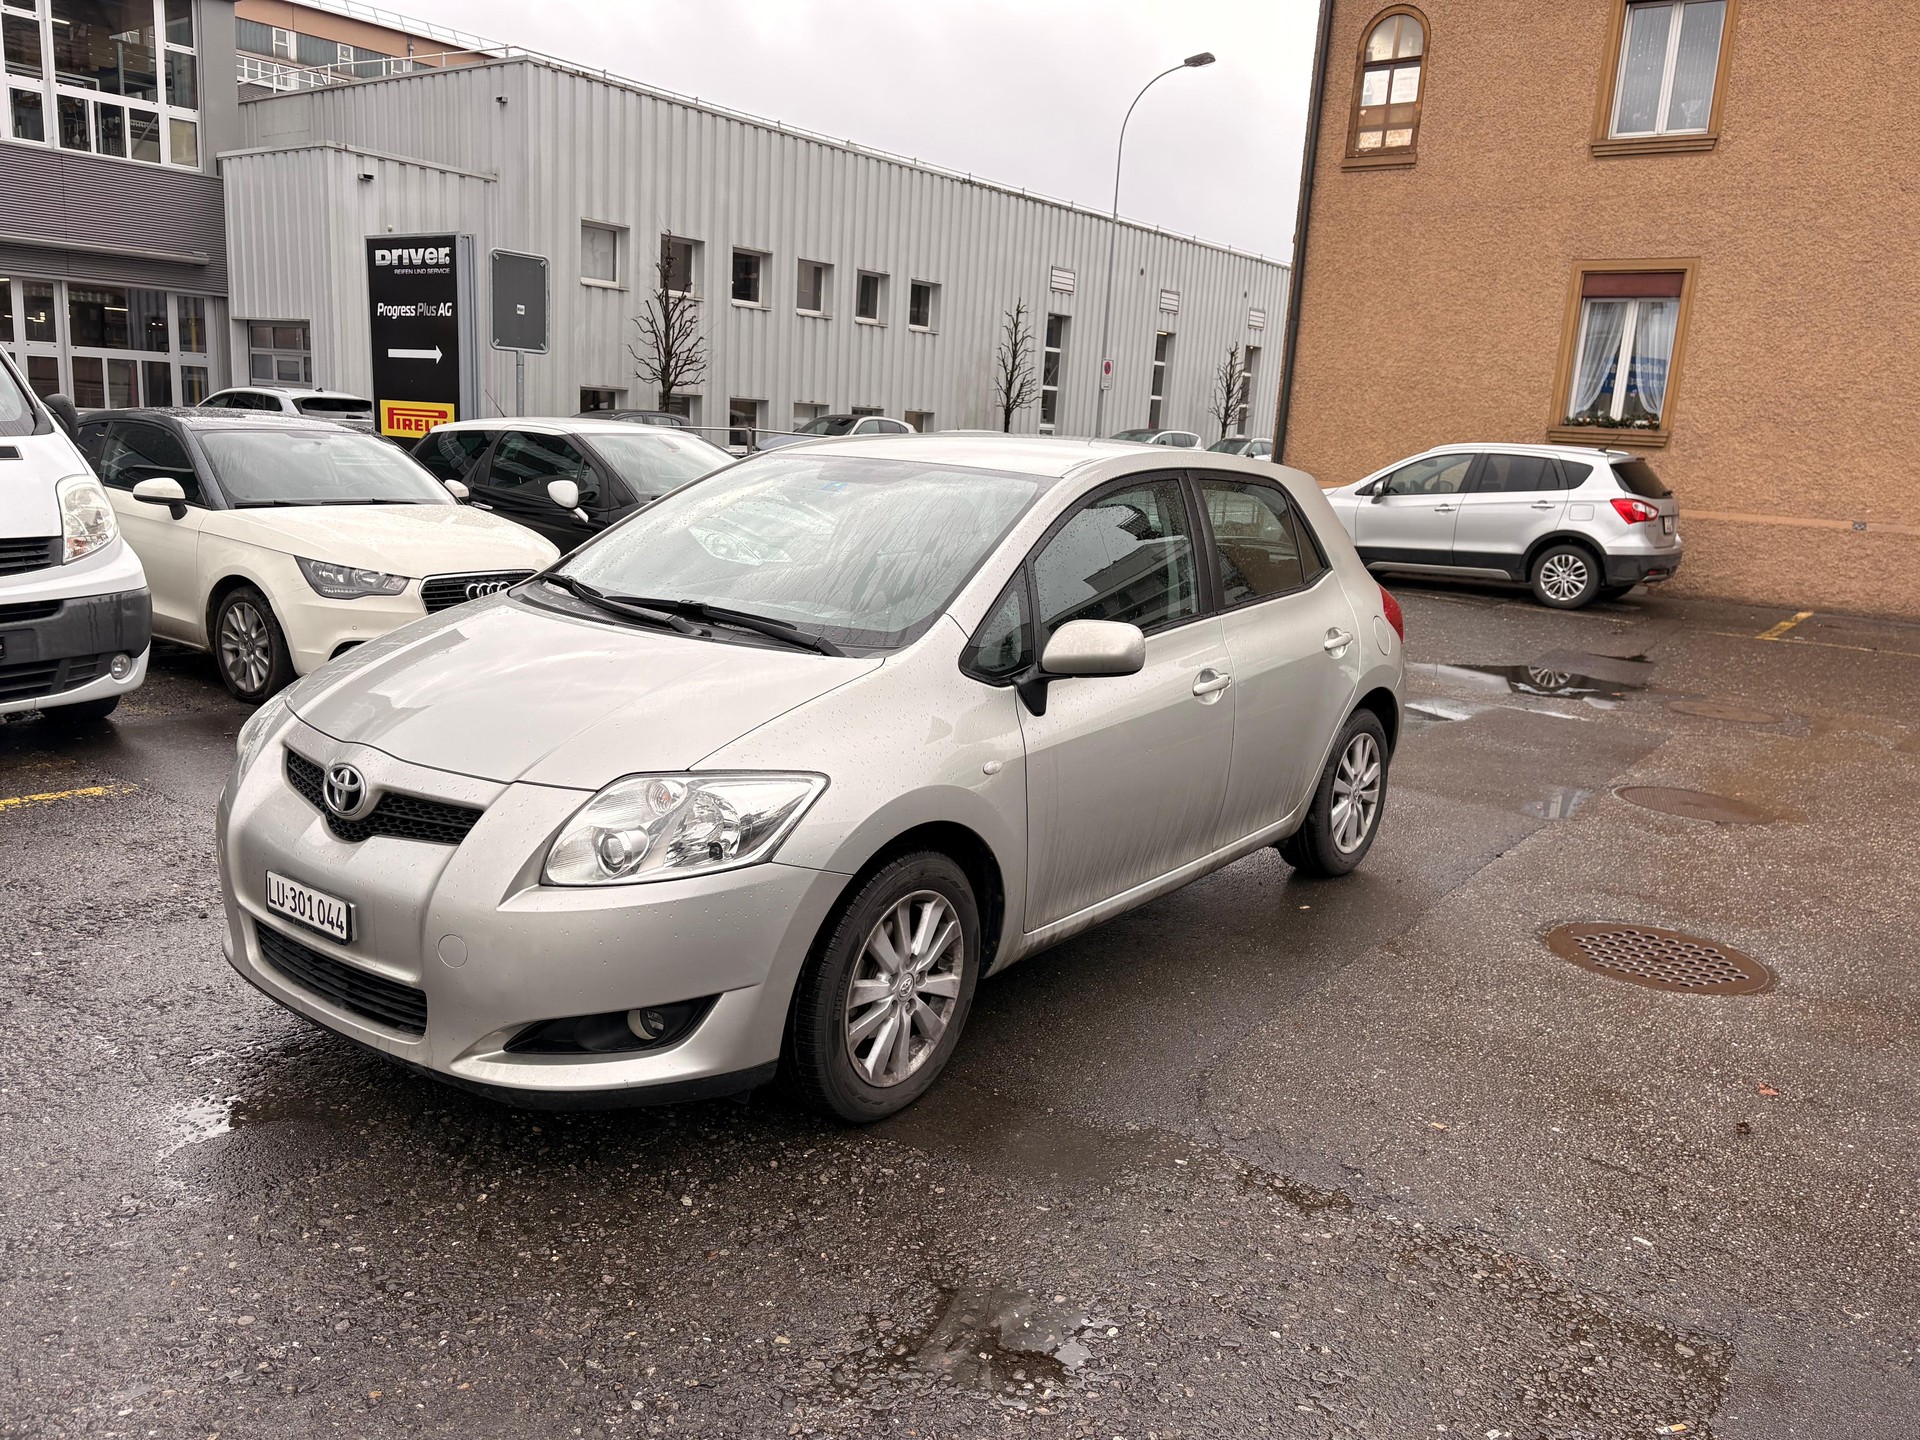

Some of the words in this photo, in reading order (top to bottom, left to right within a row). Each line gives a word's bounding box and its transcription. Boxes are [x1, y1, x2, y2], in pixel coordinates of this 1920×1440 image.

[377, 302, 416, 319] Progress
[417, 302, 437, 317] Plus
[437, 302, 452, 317] AG
